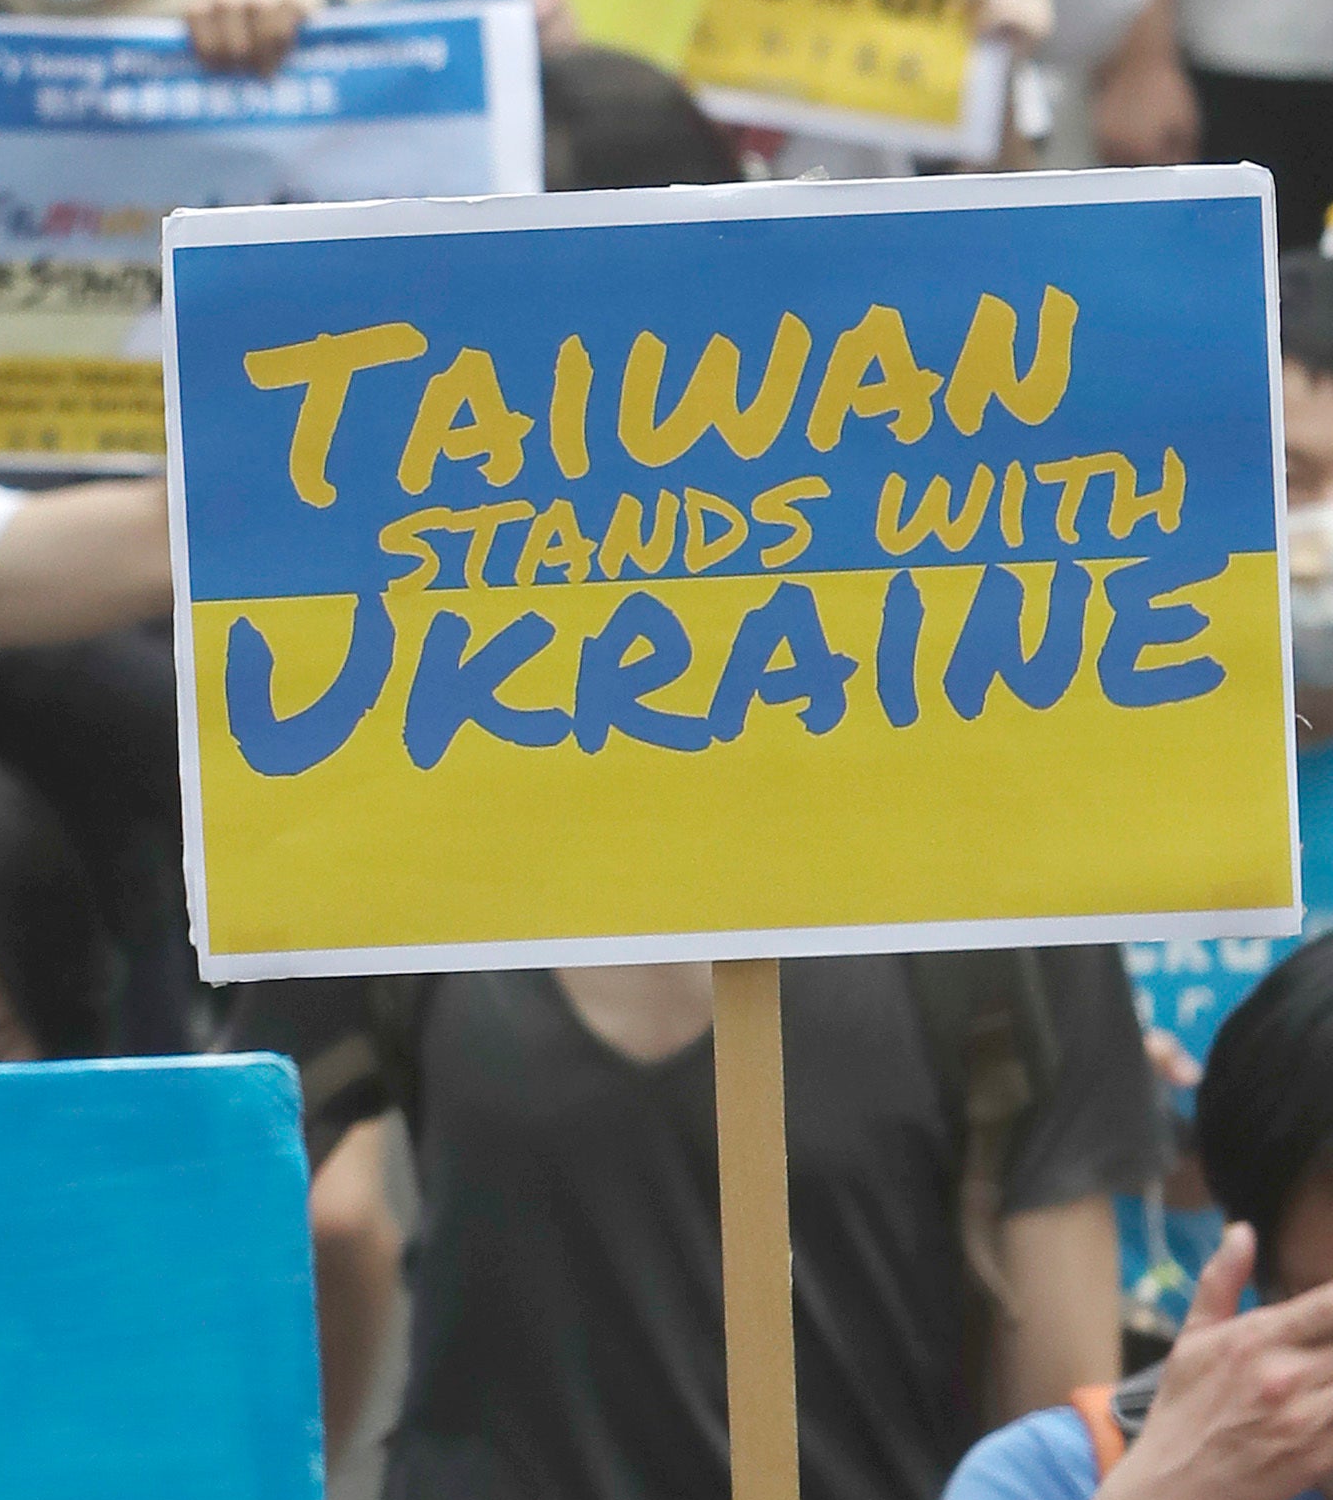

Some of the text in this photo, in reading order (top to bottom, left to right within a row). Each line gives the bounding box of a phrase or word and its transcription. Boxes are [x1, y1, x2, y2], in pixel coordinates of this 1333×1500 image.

[243, 285, 1079, 507] TAIWAN
[378, 446, 1187, 591] STANDS WITH
[226, 554, 1229, 777] UKRAINE
